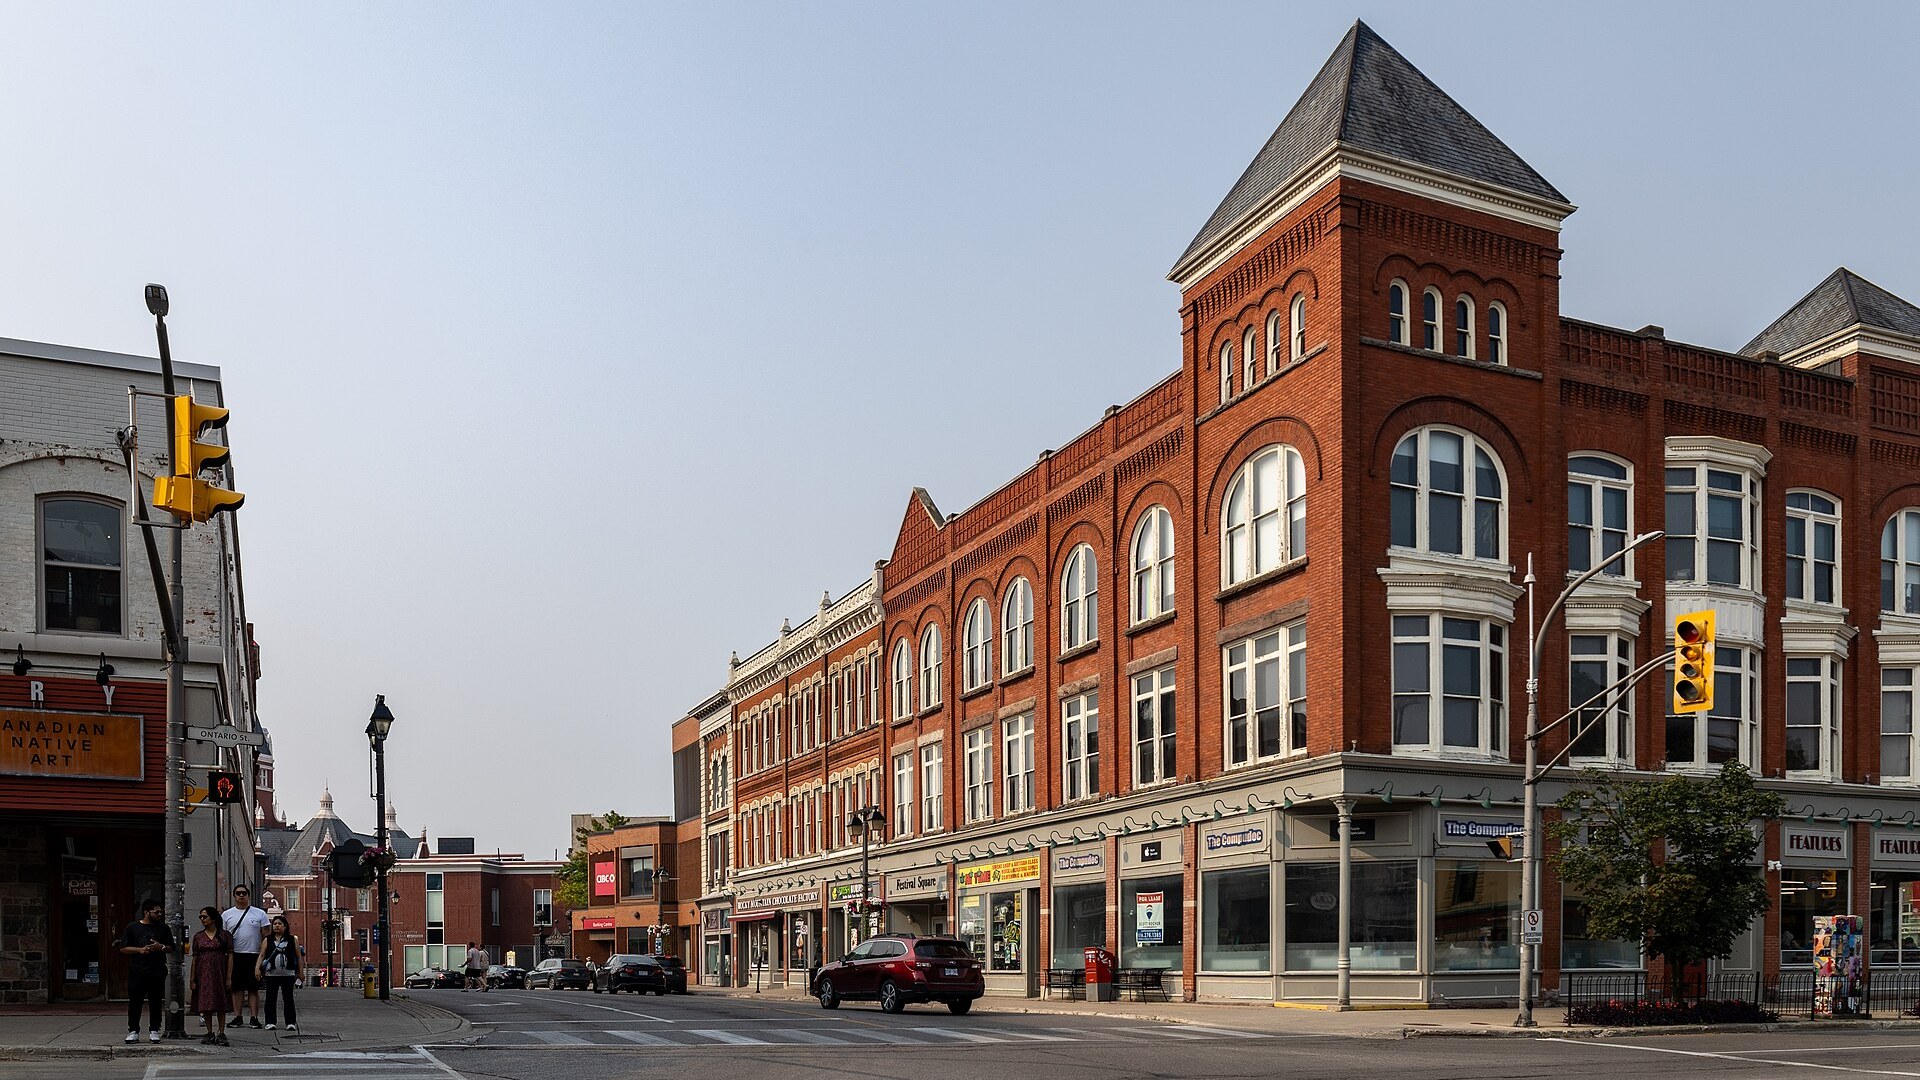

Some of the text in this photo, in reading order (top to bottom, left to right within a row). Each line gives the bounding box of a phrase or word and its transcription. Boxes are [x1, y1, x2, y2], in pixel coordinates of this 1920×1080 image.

[200, 730, 250, 742] ONTARIO St.
[12, 736, 92, 752] NATIVE
[30, 753, 73, 767] ART
[1446, 822, 1467, 834] The
[1207, 830, 1262, 848] The Compudoc
[1789, 834, 1842, 852] FEATURES
[1059, 854, 1099, 869] The Compudoc
[596, 874, 610, 884] CIBC
[896, 875, 937, 891] Festival Square
[737, 899, 751, 910] ROCKY
[772, 894, 797, 906] CHOCOLATE
[797, 891, 818, 903] FACTORY
